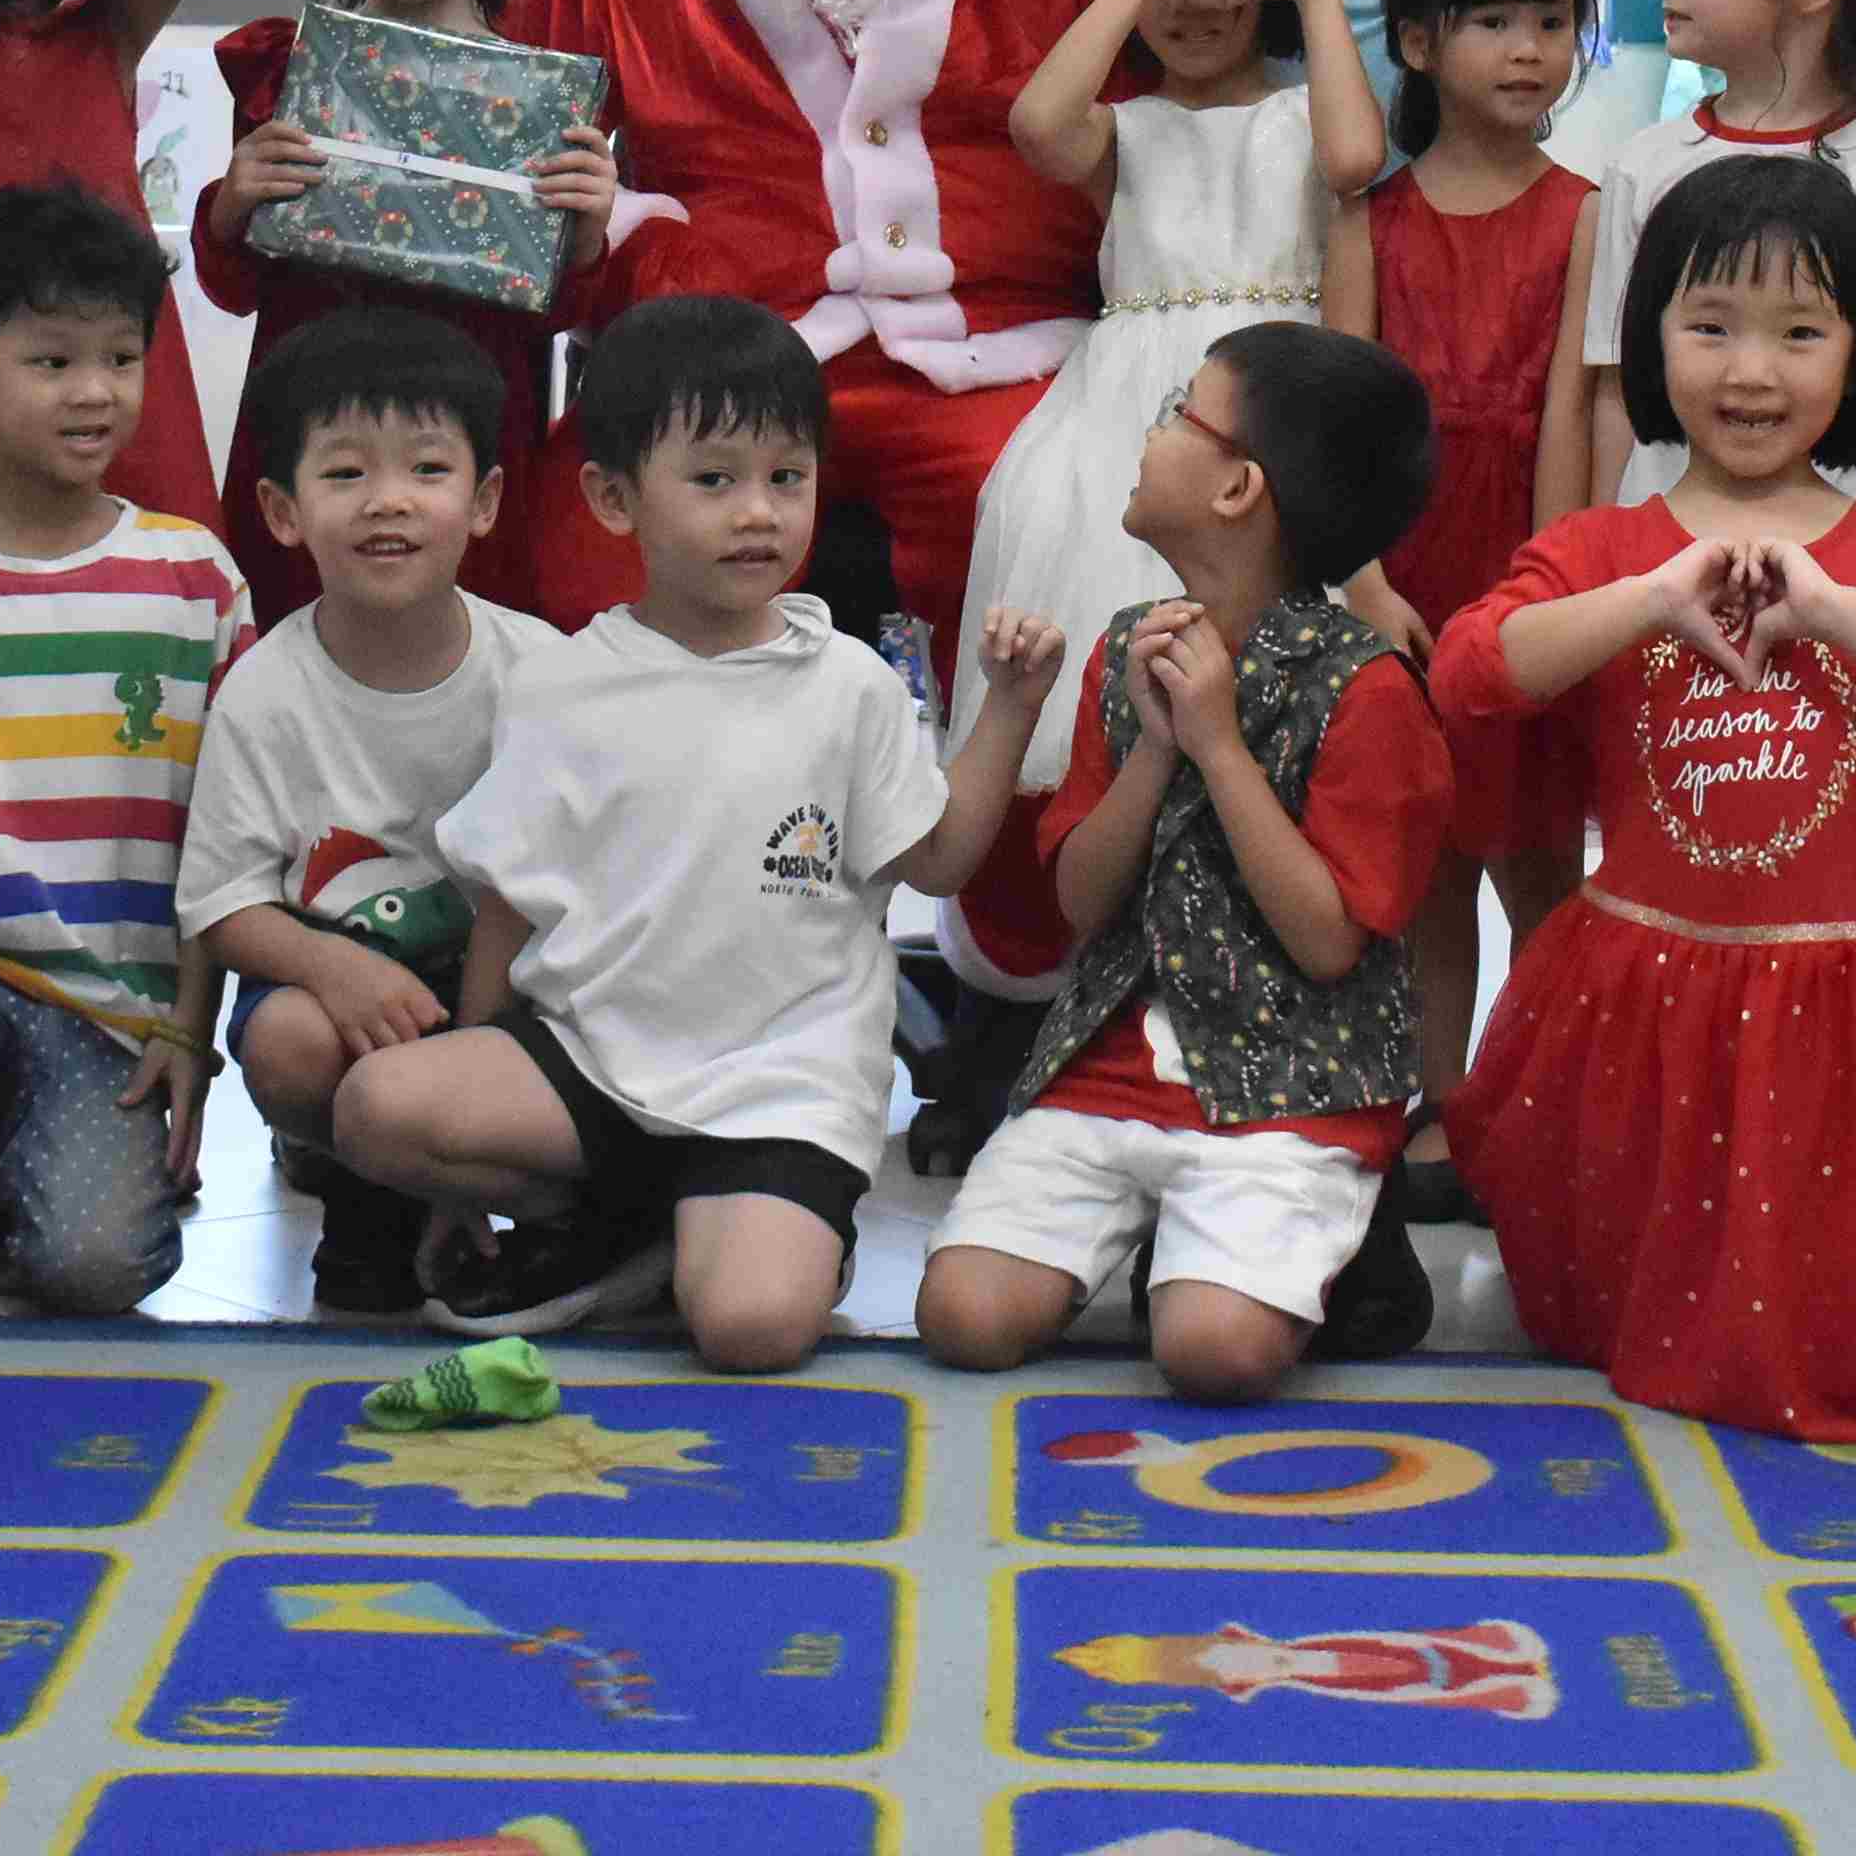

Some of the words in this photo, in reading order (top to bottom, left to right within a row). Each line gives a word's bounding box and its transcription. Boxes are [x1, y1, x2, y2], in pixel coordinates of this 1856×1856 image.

[1753, 657, 1801, 694] he
[1660, 707, 1779, 750] season
[1784, 695, 1825, 732] to
[1671, 739, 1809, 818] sparkle
[765, 805, 806, 850] WAVE
